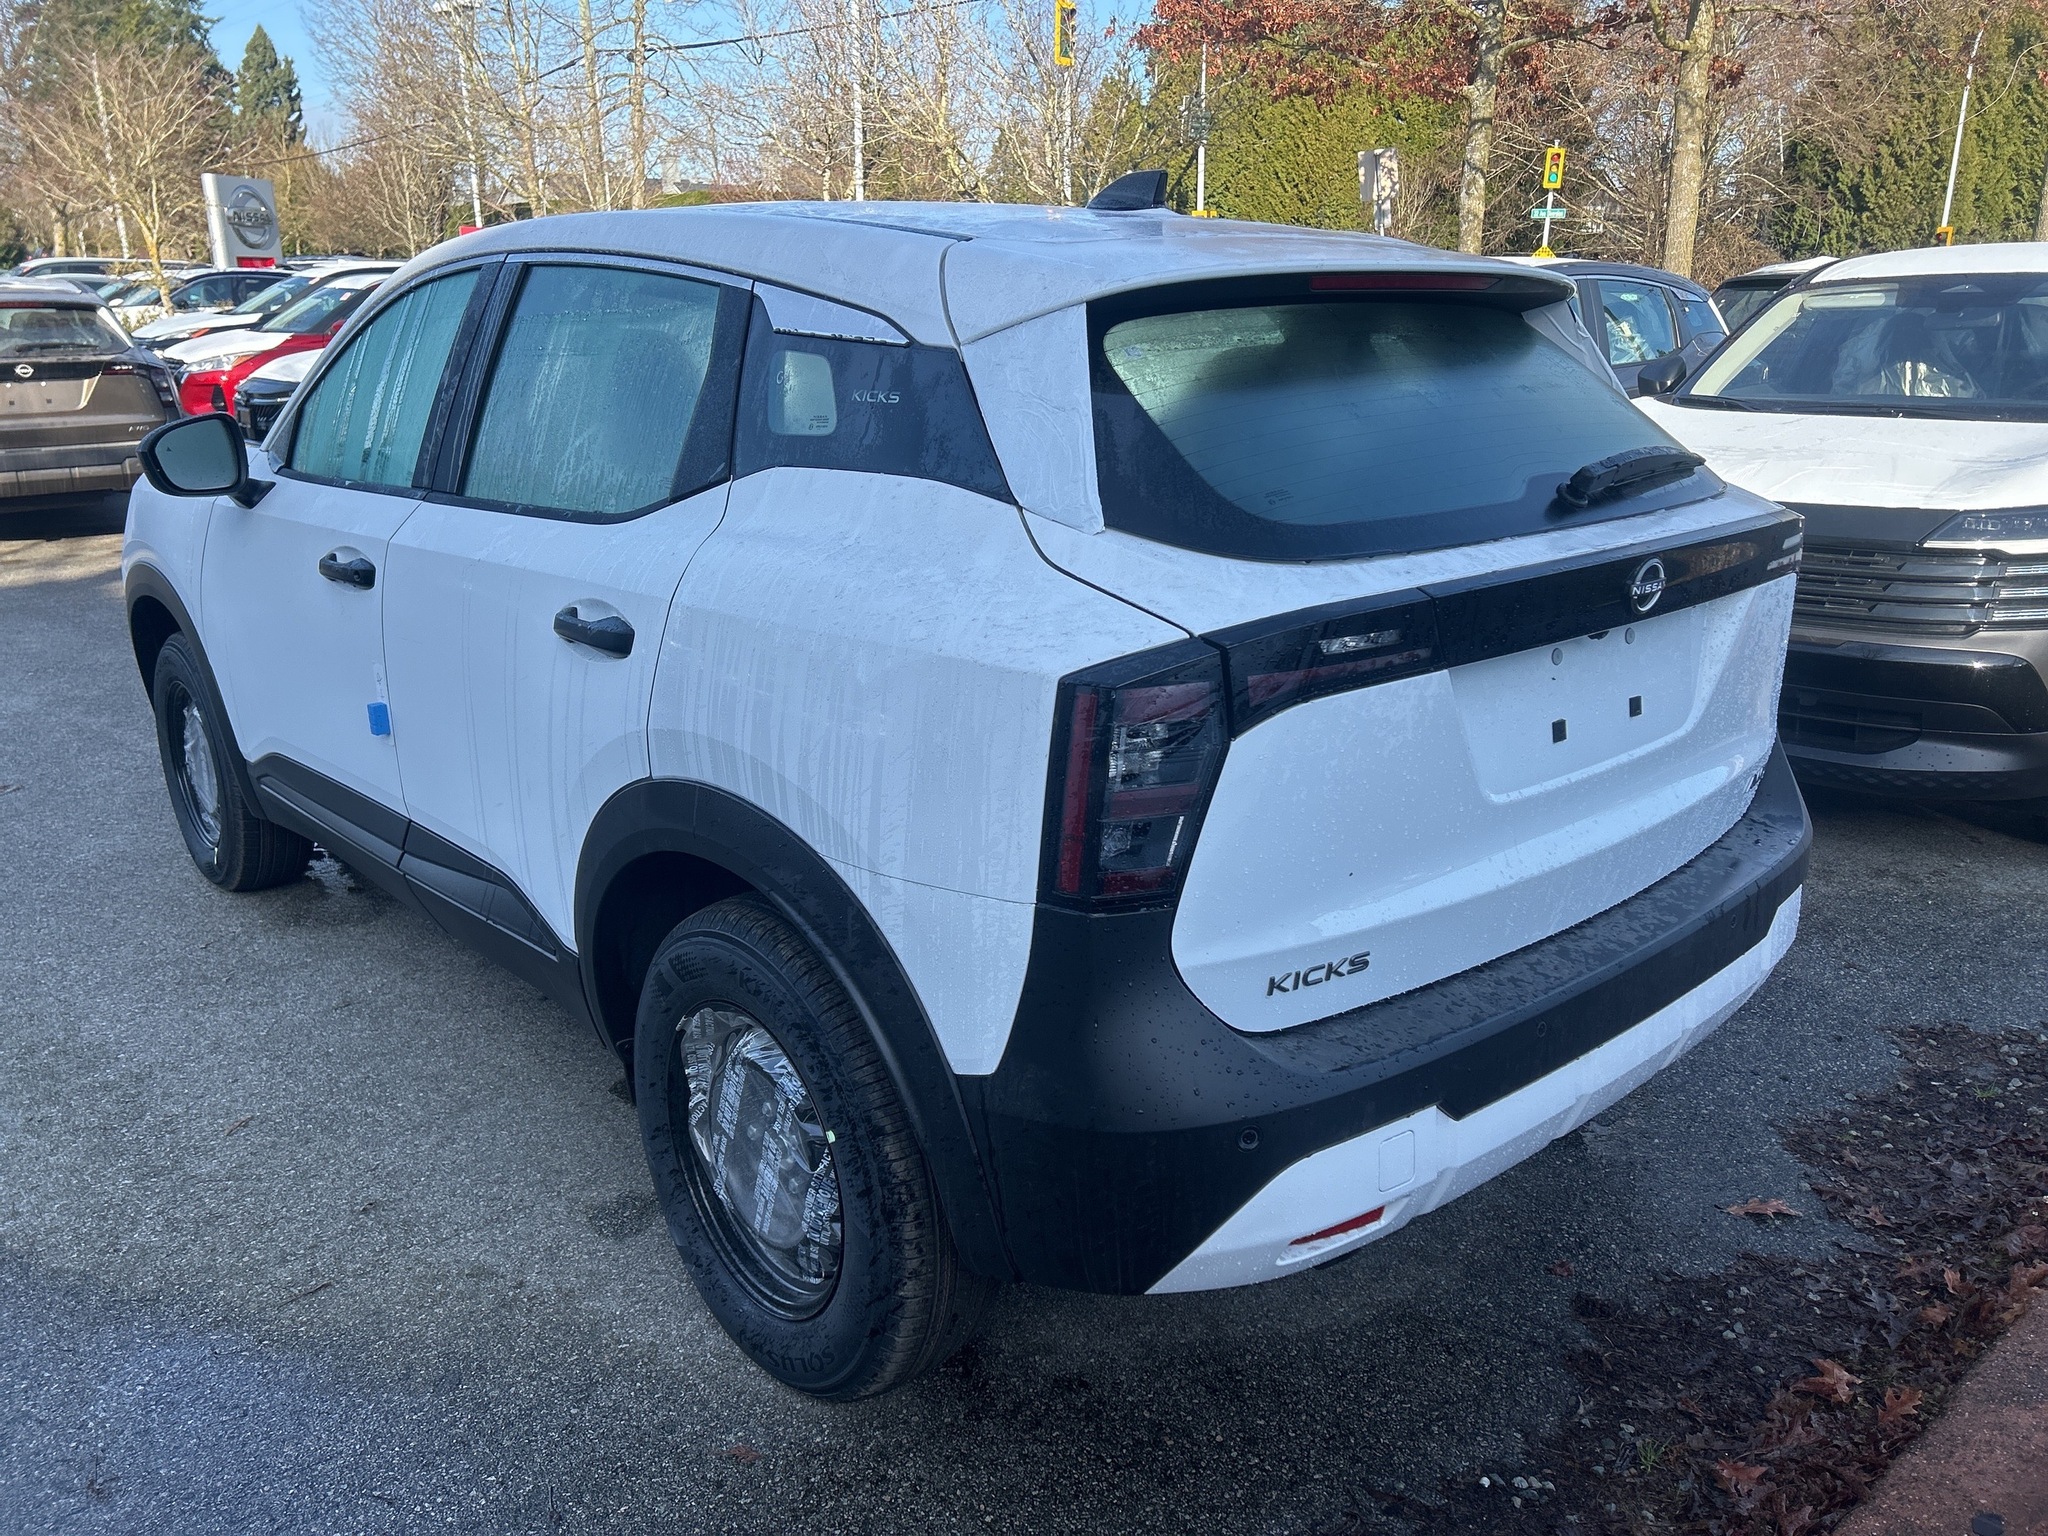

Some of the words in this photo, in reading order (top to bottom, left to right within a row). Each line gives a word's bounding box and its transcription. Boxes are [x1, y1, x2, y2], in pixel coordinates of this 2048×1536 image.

[852, 389, 900, 403] KICKS
[1266, 950, 1371, 997] KICKS
[767, 1346, 835, 1373] SOLUS
